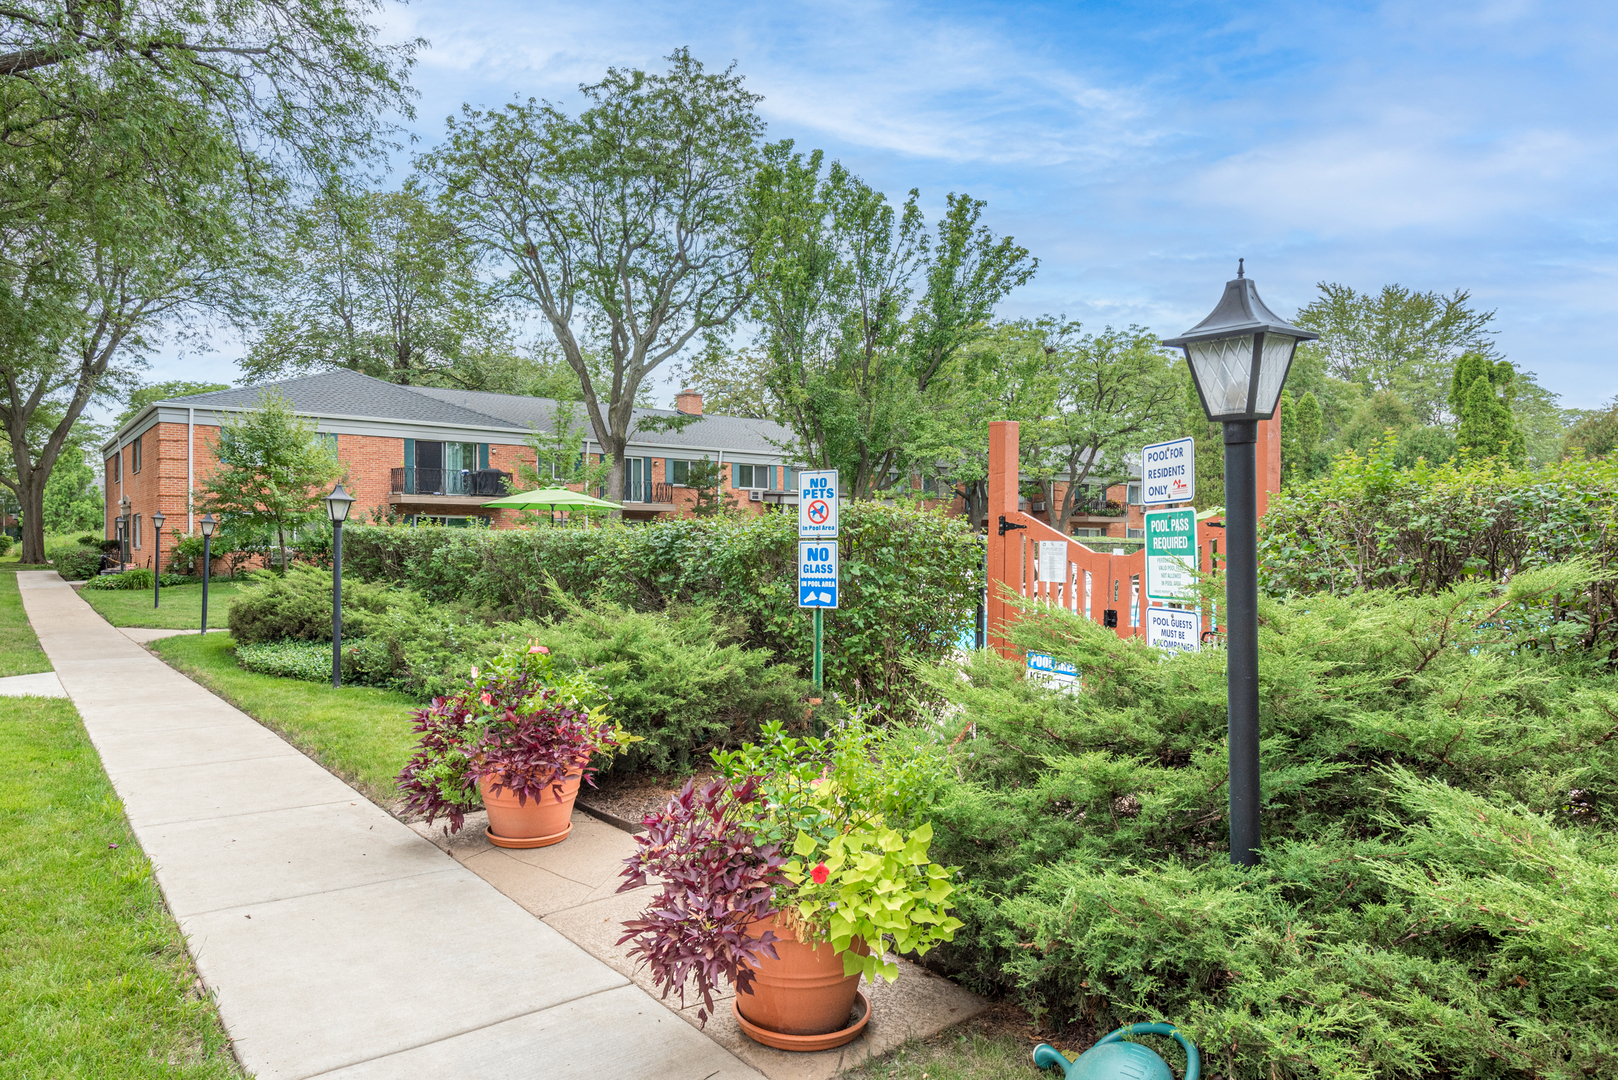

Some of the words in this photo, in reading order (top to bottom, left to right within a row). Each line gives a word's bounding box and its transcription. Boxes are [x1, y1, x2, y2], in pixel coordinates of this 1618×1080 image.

[1148, 450, 1169, 462] POOL
[1170, 447, 1184, 459] FOR
[1148, 465, 1185, 479] RESIDENTS
[809, 477, 828, 488] NO
[803, 488, 834, 499] PETS
[1148, 485, 1168, 496] ONLY
[1151, 519, 1169, 532] POOL
[1171, 518, 1189, 531] PASS
[1153, 536, 1188, 549] REQUIRED
[807, 547, 829, 562] NO
[803, 564, 833, 574] GLASS
[821, 580, 835, 588] AREA
[1152, 616, 1169, 626] POOL
[1171, 618, 1192, 629] GUESTS
[1161, 629, 1177, 638] MUST
[1179, 631, 1185, 639] BE
[1152, 638, 1194, 651] ACOMPANIED
